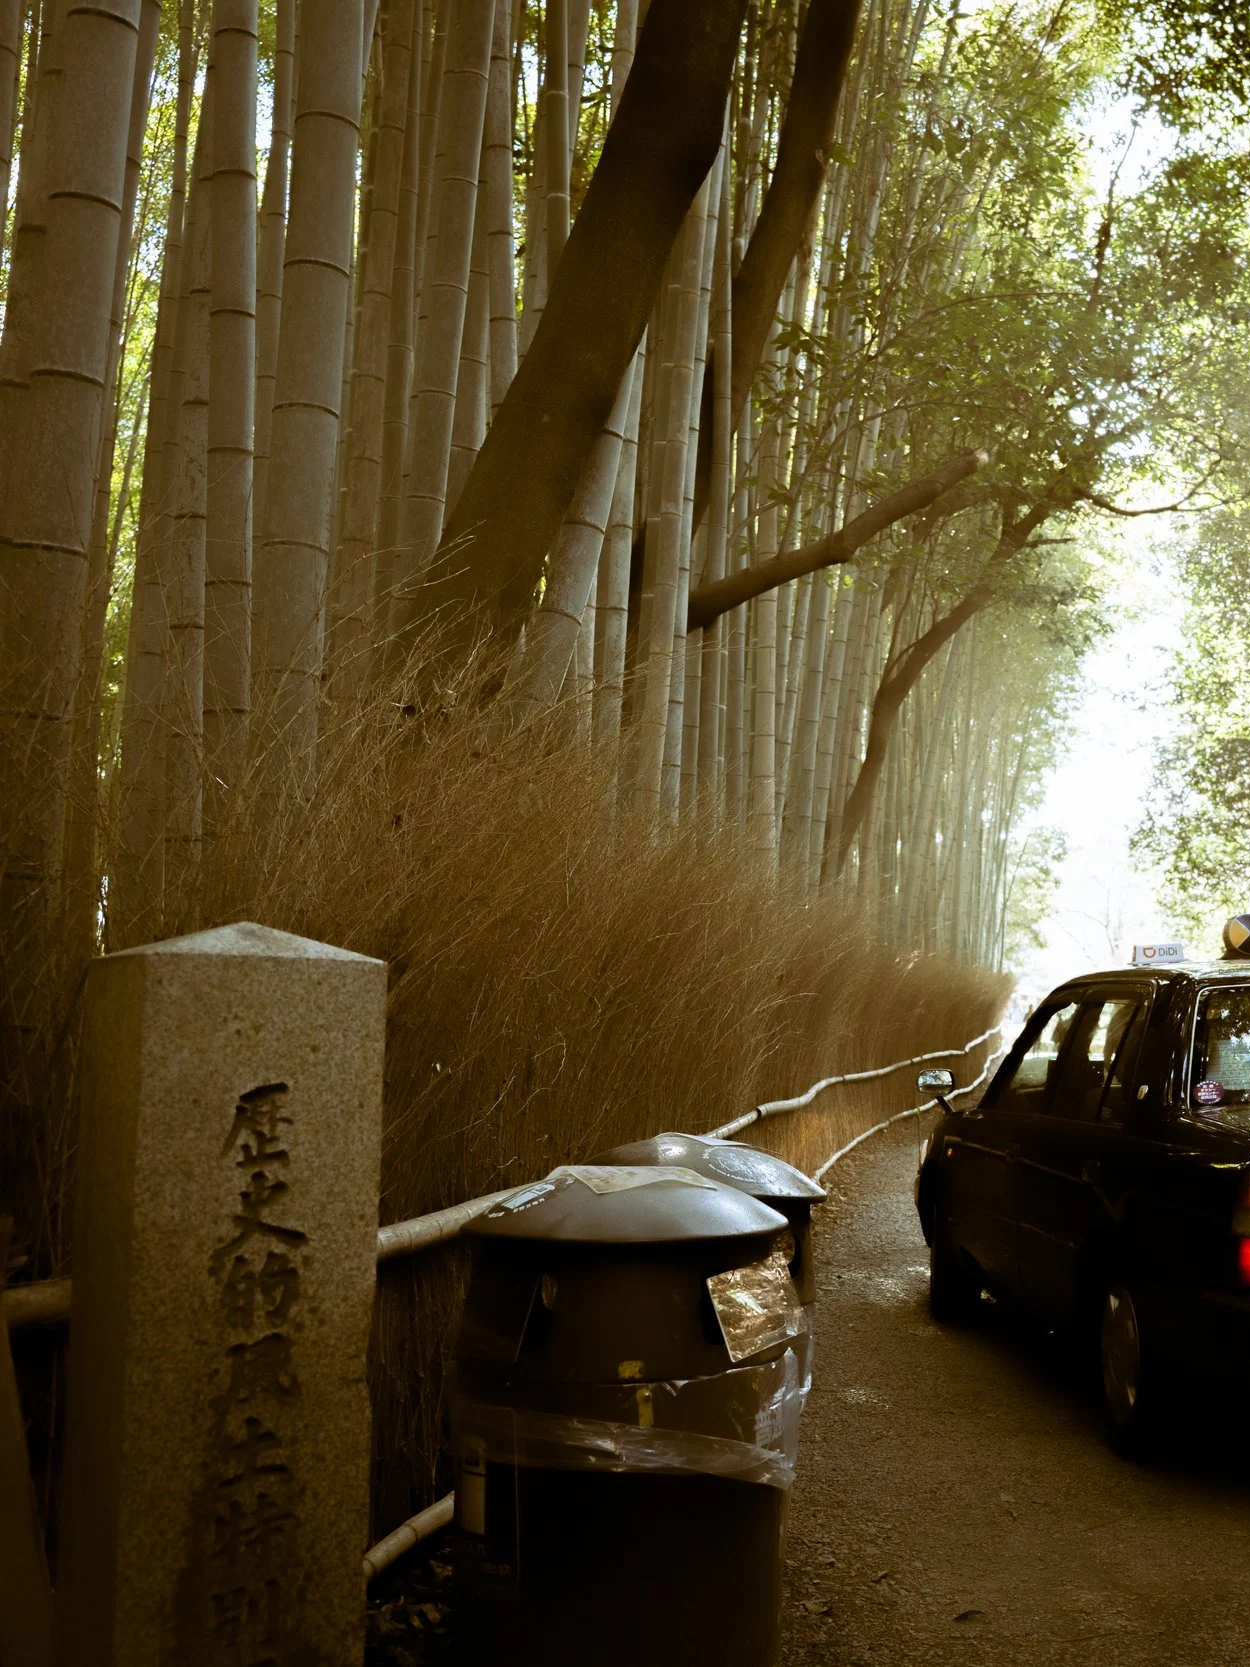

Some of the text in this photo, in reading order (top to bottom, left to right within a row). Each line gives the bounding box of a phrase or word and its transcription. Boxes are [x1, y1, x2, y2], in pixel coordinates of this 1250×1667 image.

[1158, 947, 1178, 957] DiDi
[207, 1081, 310, 1667] 歴史的風土特別
